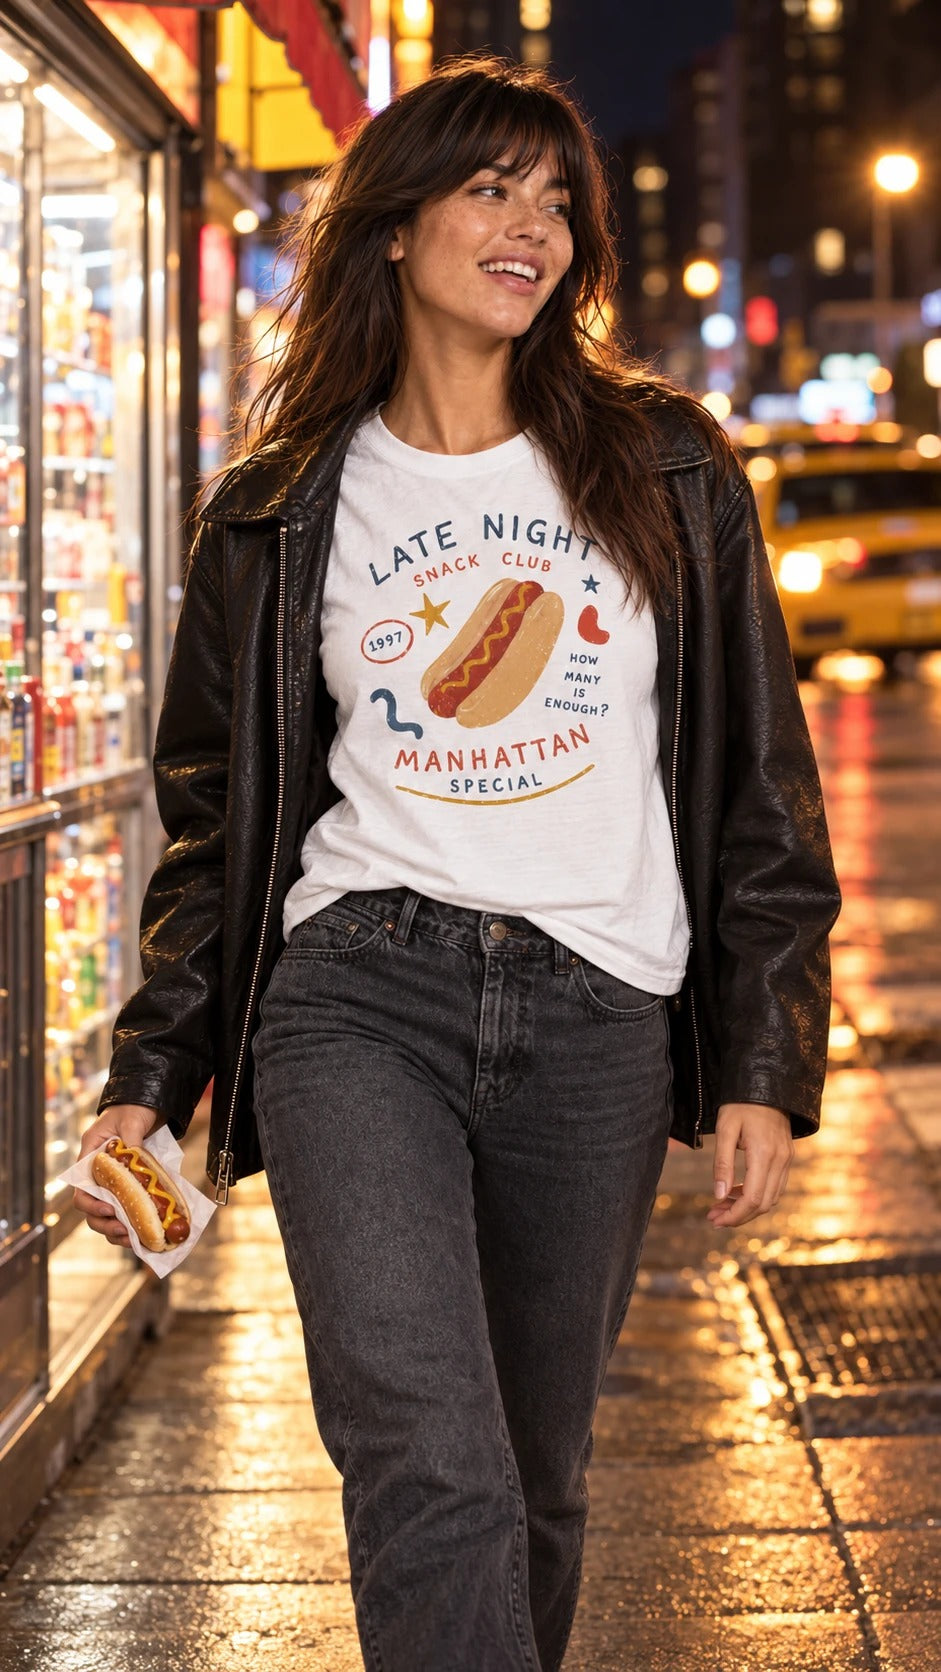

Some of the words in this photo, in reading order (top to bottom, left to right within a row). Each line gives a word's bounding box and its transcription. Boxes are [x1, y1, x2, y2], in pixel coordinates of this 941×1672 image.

[369, 520, 457, 586] LATE
[483, 513, 598, 561] NIGHT
[413, 554, 480, 587] SNACK
[502, 552, 552, 572] CLUB
[368, 631, 403, 652] 1997
[569, 653, 599, 666] HOW
[564, 671, 601, 685] MANY
[573, 687, 586, 698] IS
[544, 697, 609, 717] ENOUGH?
[394, 723, 590, 772] MANHATTAN
[450, 773, 543, 794] SPECIAL
